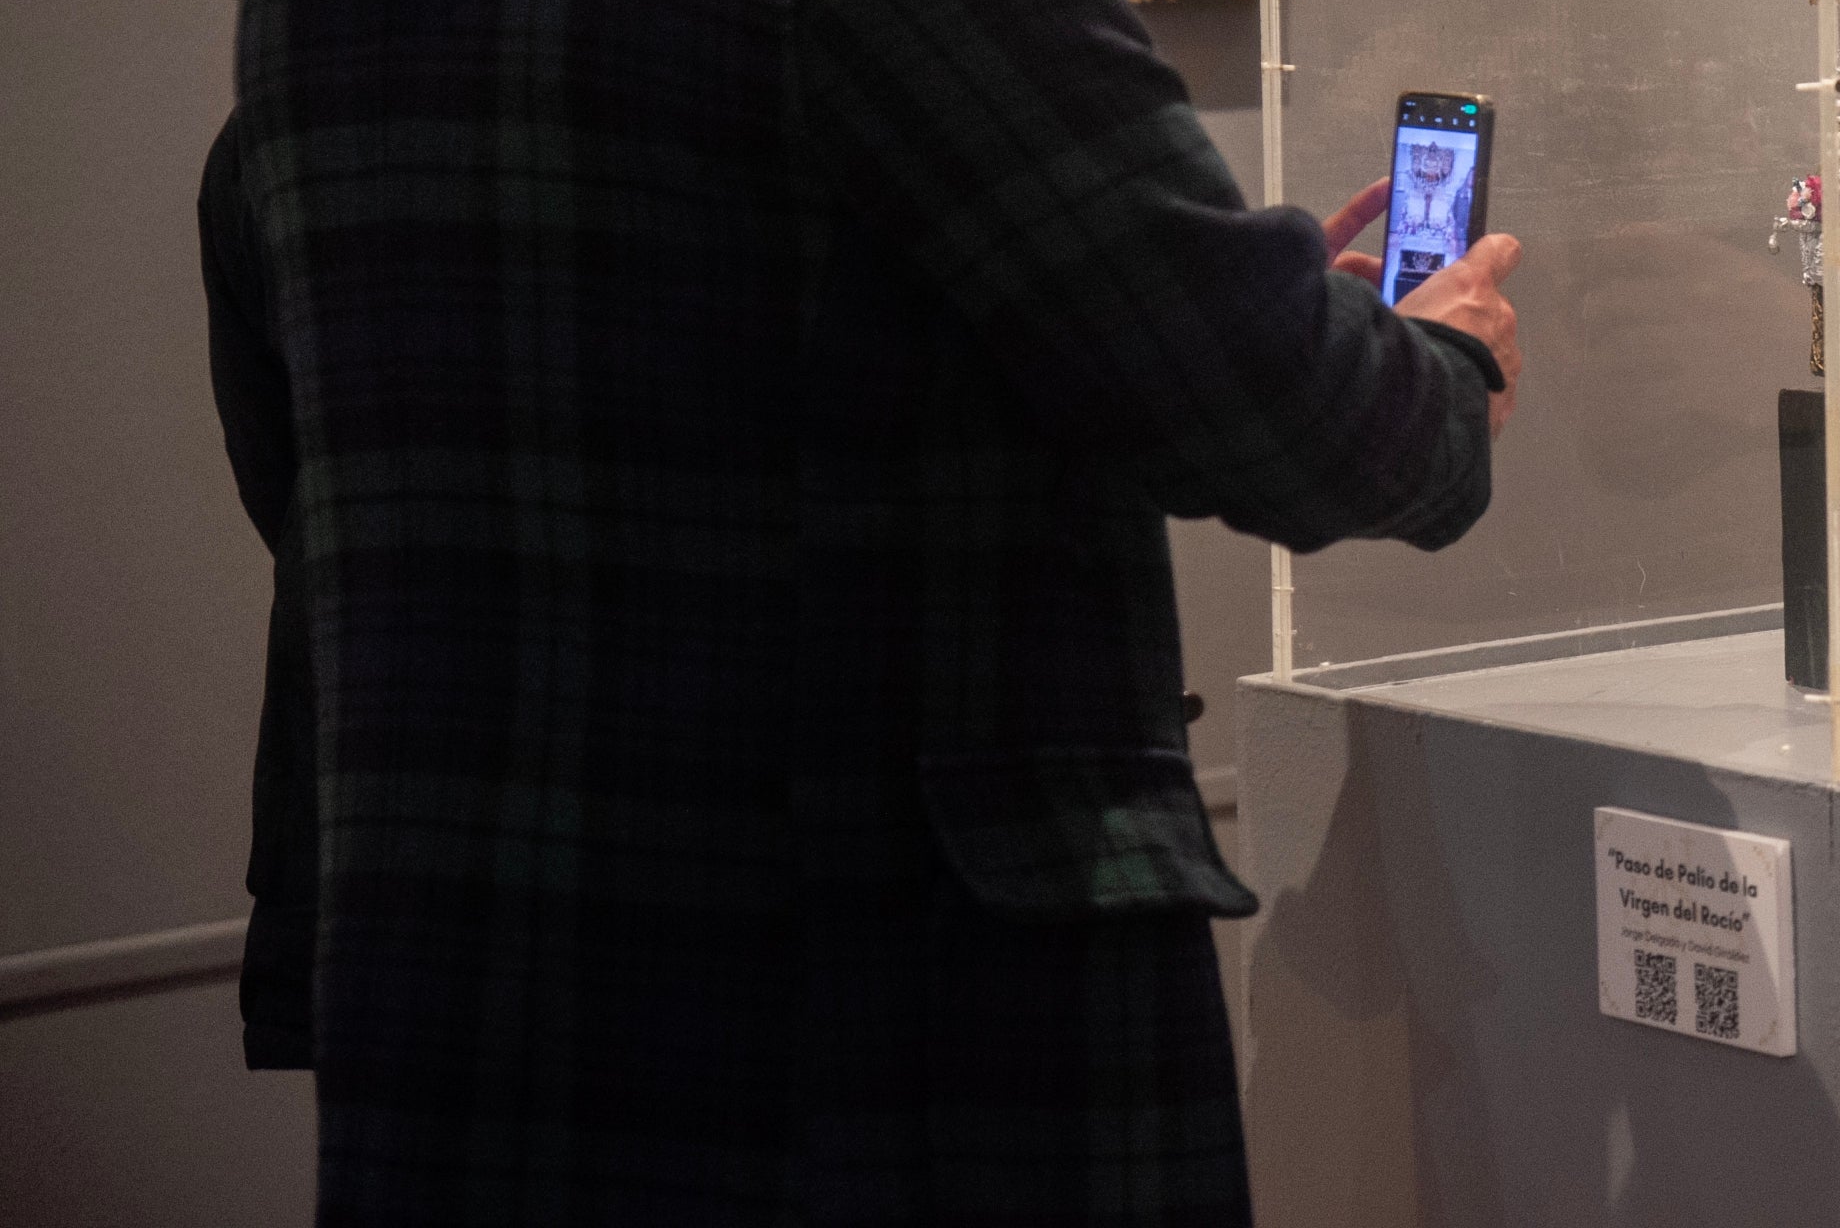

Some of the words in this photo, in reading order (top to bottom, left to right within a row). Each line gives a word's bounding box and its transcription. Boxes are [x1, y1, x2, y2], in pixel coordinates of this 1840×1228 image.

[1608, 847, 1651, 876] "Paso
[1655, 858, 1674, 880] de
[1719, 871, 1738, 894] de
[1743, 876, 1757, 897] la
[1619, 887, 1669, 918] Virgen
[1673, 898, 1696, 922] del
